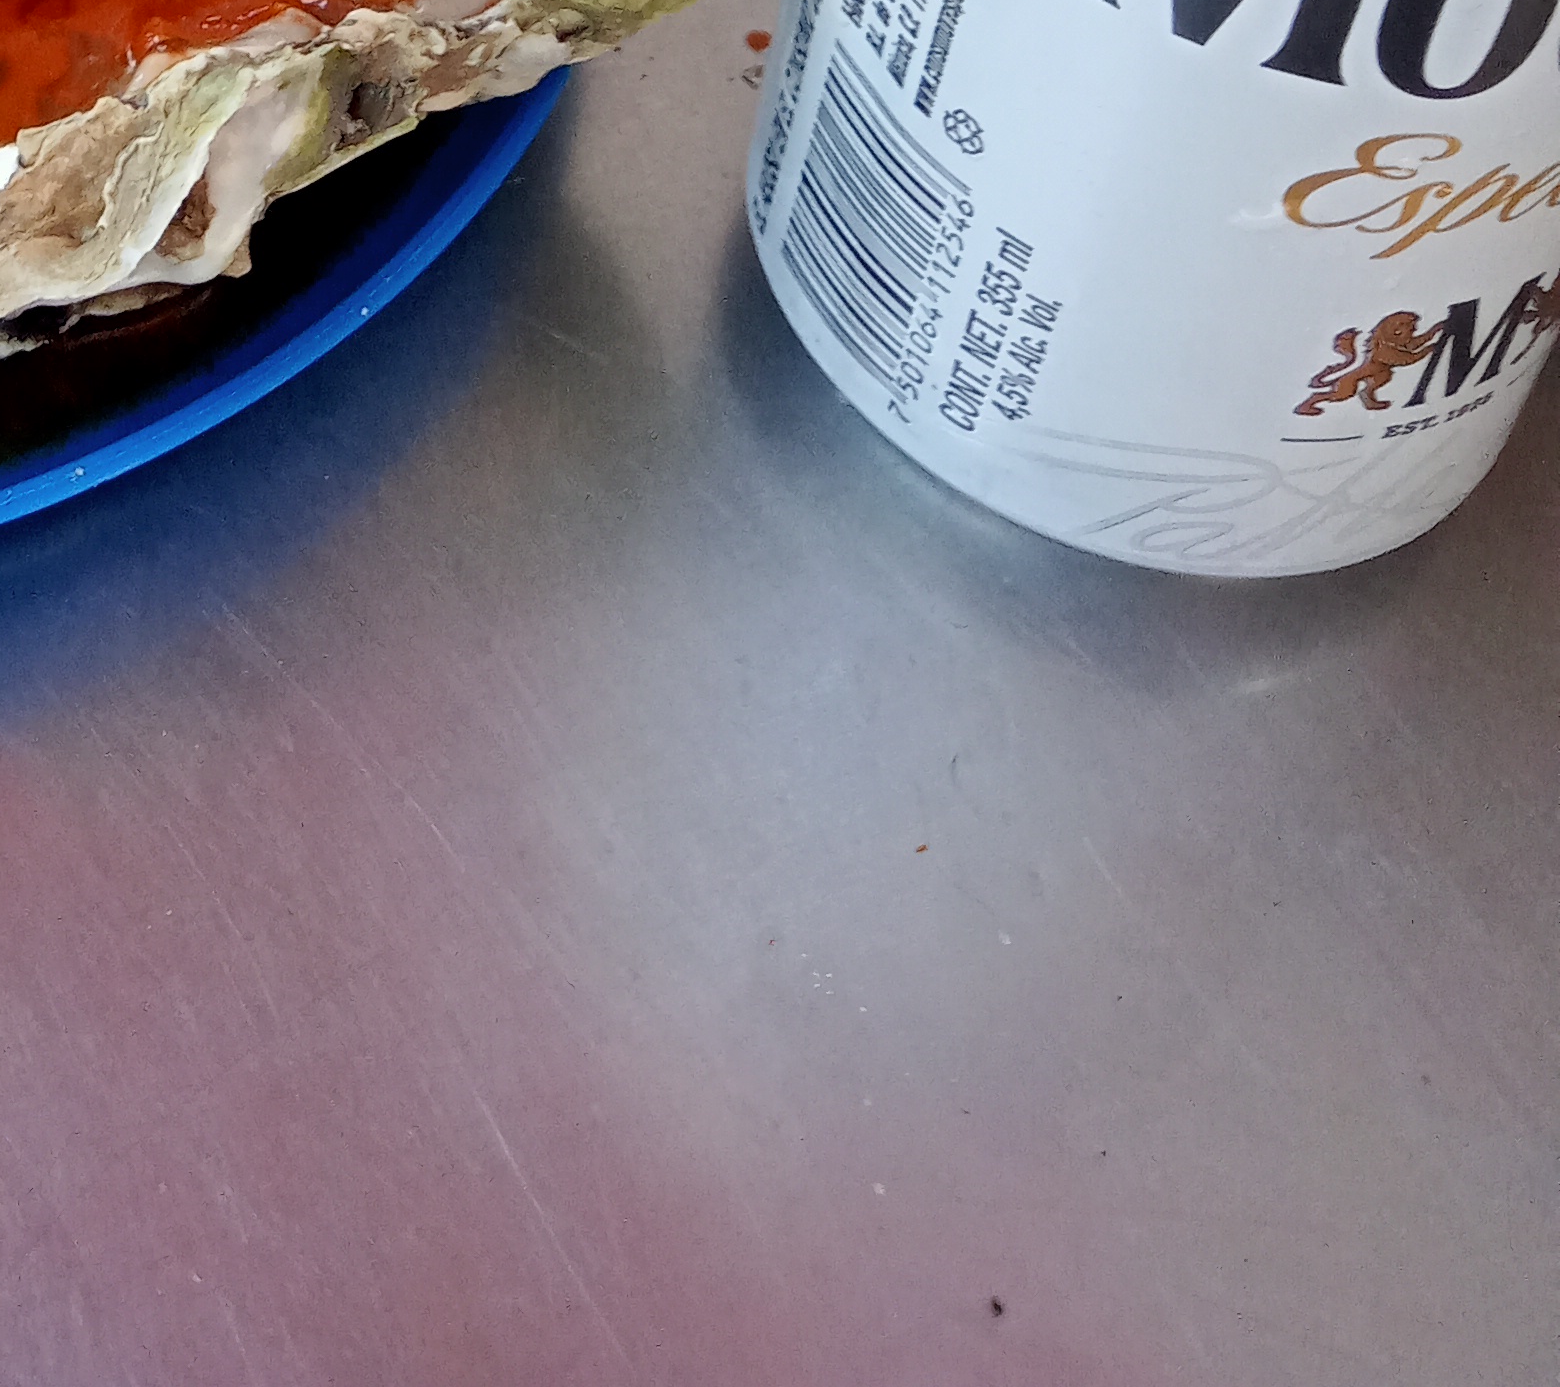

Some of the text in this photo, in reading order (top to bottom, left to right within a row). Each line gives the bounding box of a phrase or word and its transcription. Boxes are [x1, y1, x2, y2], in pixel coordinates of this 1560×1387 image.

[1283, 133, 1560, 259] Espe
[888, 399, 911, 424] 7
[926, 194, 975, 294] 112546
[938, 227, 1035, 432] CONT. NET. 355 ml
[991, 367, 1037, 421] 4,5%
[1018, 293, 1064, 333] Vol.
